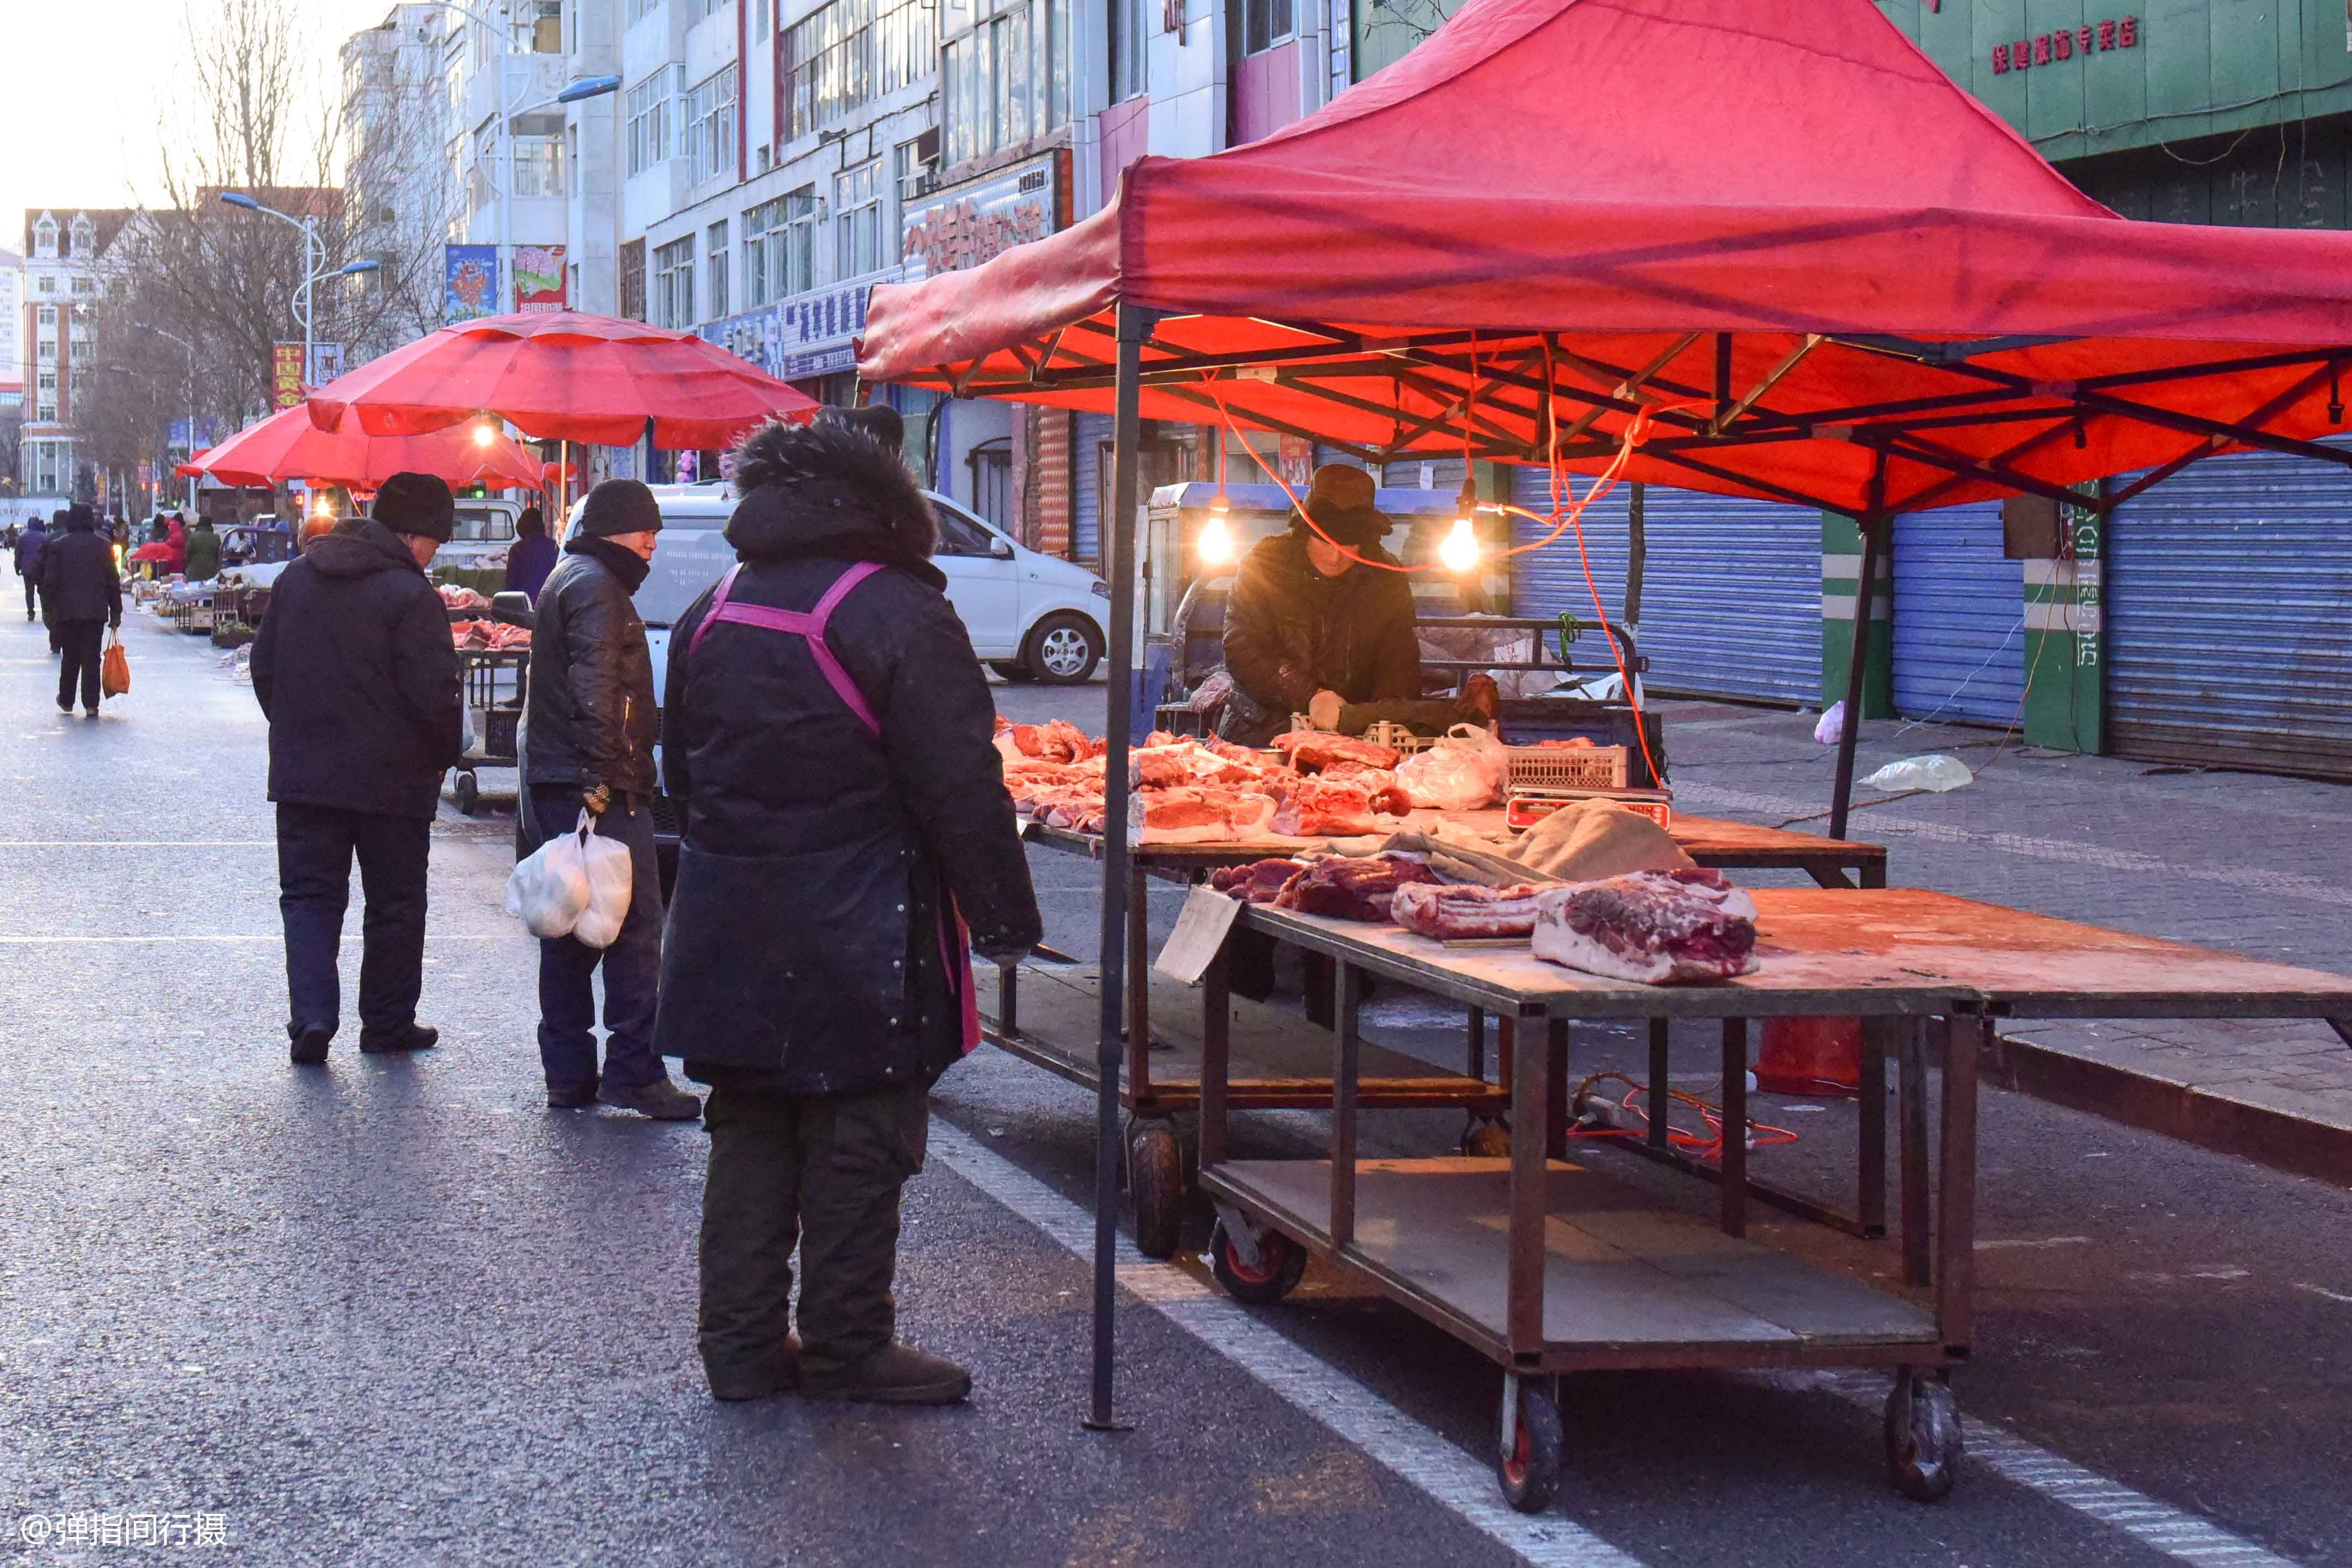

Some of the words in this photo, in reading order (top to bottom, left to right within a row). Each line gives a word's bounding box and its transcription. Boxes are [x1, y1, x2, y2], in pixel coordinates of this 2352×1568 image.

[1992, 14, 2138, 75] 保健服饰专卖店
